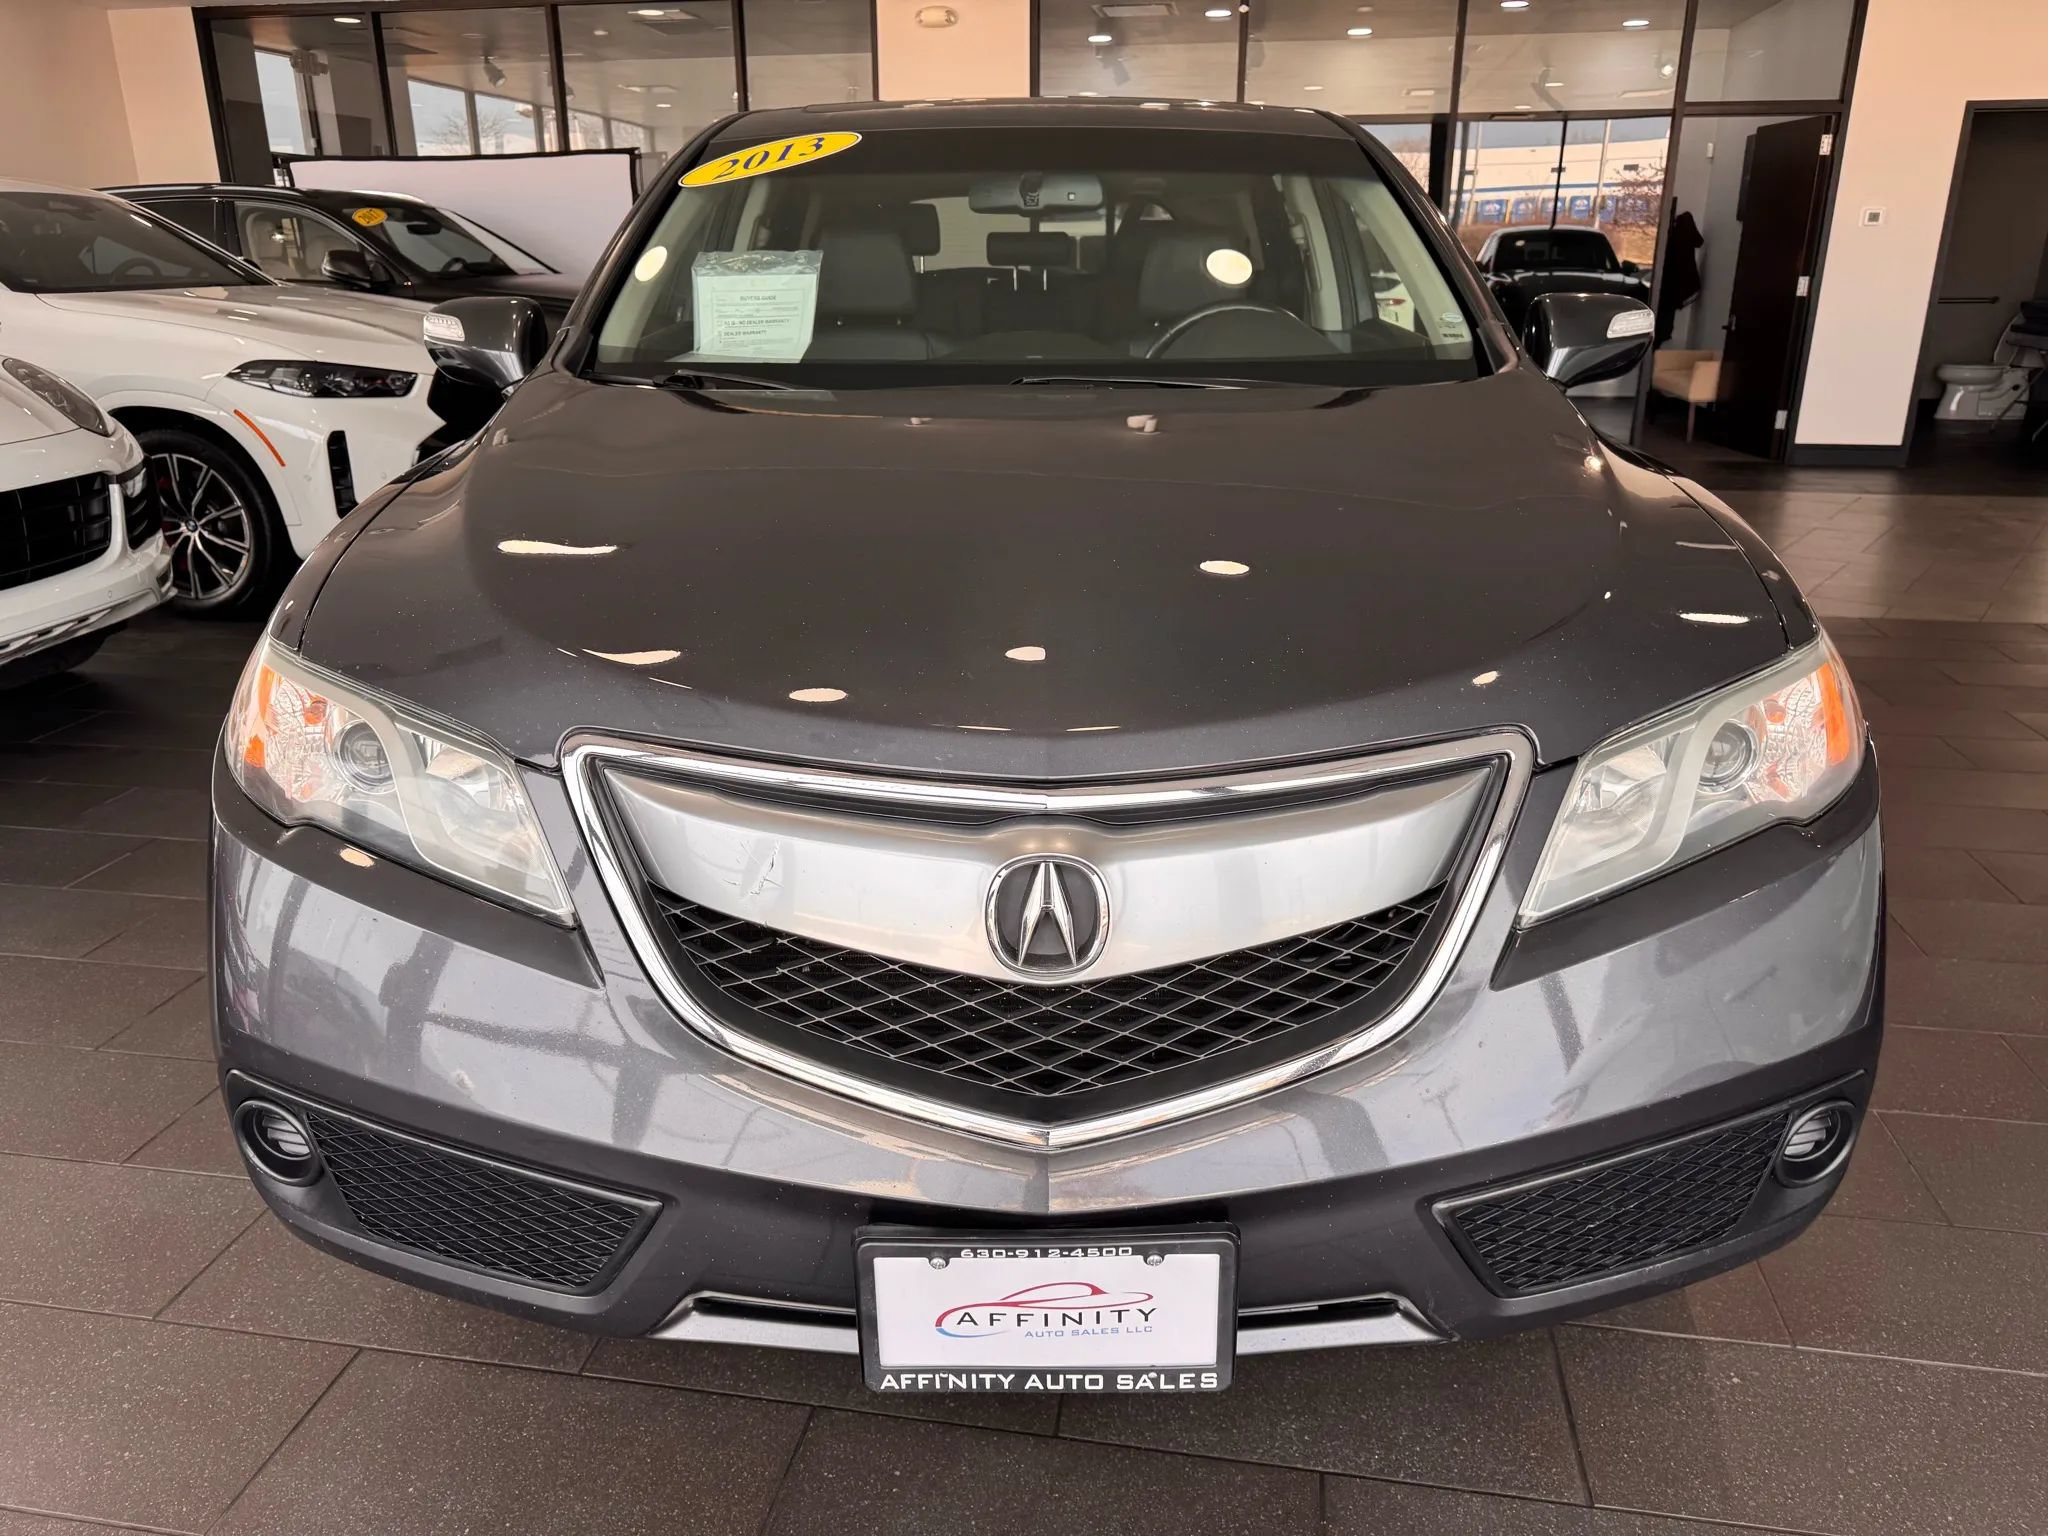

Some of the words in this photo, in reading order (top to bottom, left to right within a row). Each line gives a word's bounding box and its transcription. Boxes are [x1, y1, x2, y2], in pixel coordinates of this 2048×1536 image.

[713, 136, 825, 180] 2013
[960, 1246, 1133, 1259] 630-912-4500
[956, 1307, 1157, 1328] AFFINITY
[1024, 1330, 1064, 1338] AUTO
[1071, 1327, 1119, 1336] SALES
[1126, 1326, 1153, 1334] LLC
[880, 1373, 1016, 1390] AFFINITY
[1024, 1373, 1104, 1390] AUTO
[1116, 1372, 1217, 1390] SALES
